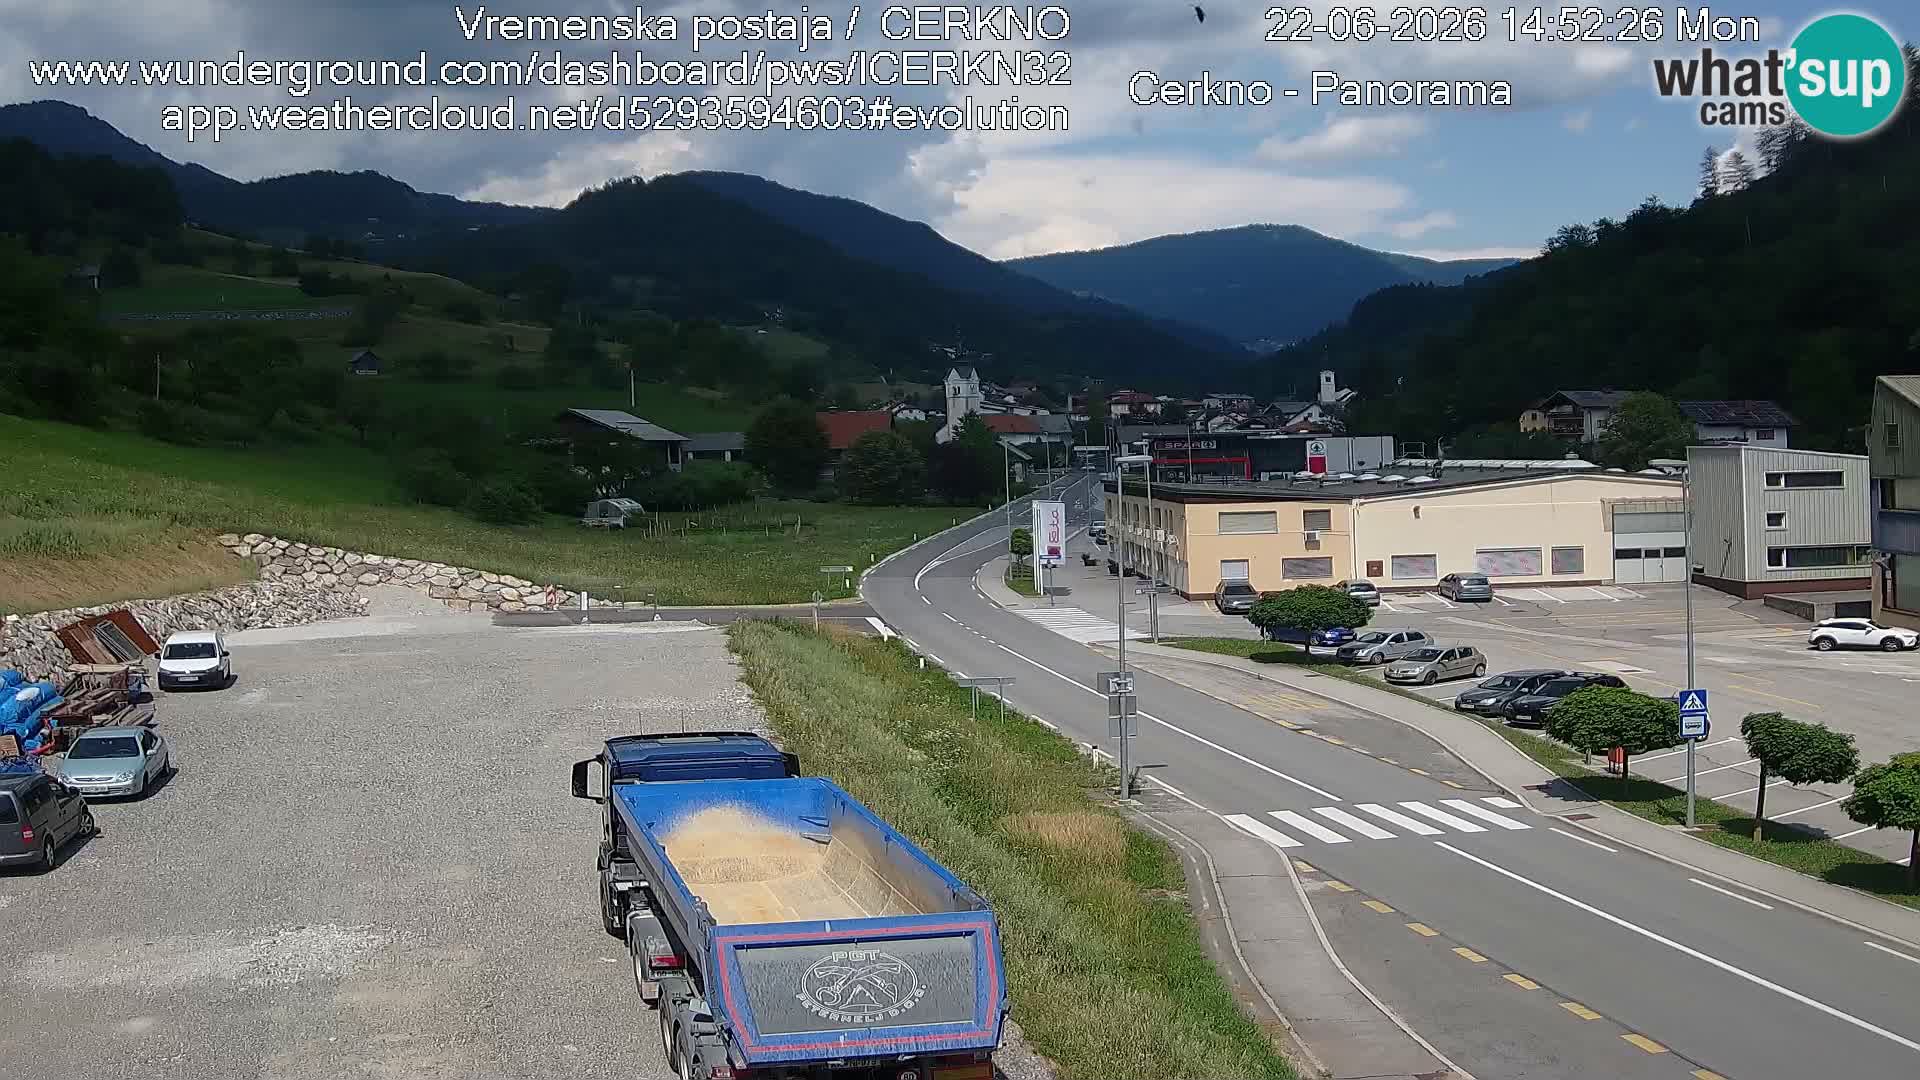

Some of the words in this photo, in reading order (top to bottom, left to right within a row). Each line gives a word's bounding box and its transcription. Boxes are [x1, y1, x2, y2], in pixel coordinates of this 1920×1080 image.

[1164, 441, 1201, 449] SPAR
[832, 949, 880, 962] PGT
[795, 993, 884, 1023] PETERNELJ
